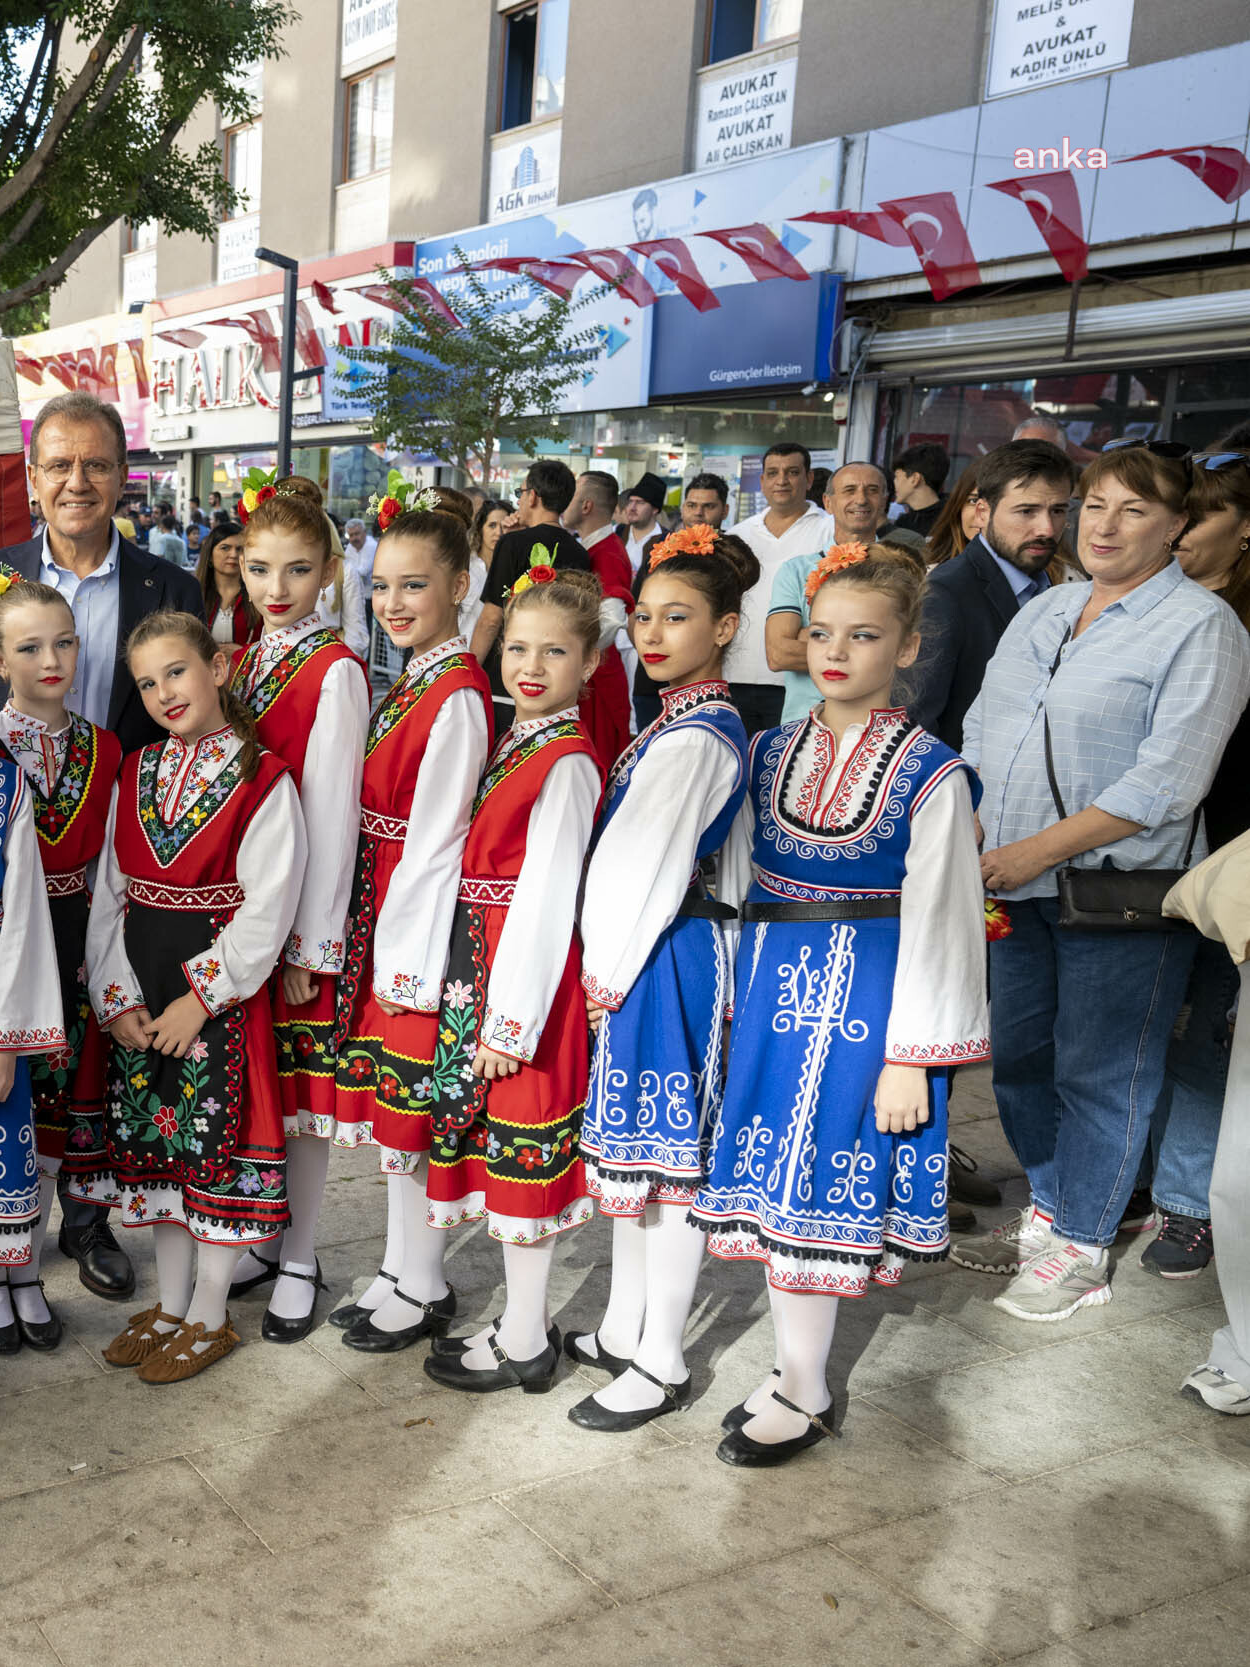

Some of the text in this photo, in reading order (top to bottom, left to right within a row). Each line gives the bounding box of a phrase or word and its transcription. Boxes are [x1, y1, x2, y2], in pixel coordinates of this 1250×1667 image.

[1055, 15, 1066, 28] &
[1022, 25, 1098, 57] AVUKAT
[1010, 41, 1107, 79] KADİR ÜNLÜ
[720, 71, 777, 101] AVUKAT
[708, 90, 787, 122] Ramazan ÇALIŞKAN
[717, 113, 774, 142] AVUKAT
[706, 133, 783, 164] Ali ÇALIŞKAN
[495, 191, 524, 214] AGK
[418, 256, 444, 275] Son
[331, 401, 348, 411] Türk
